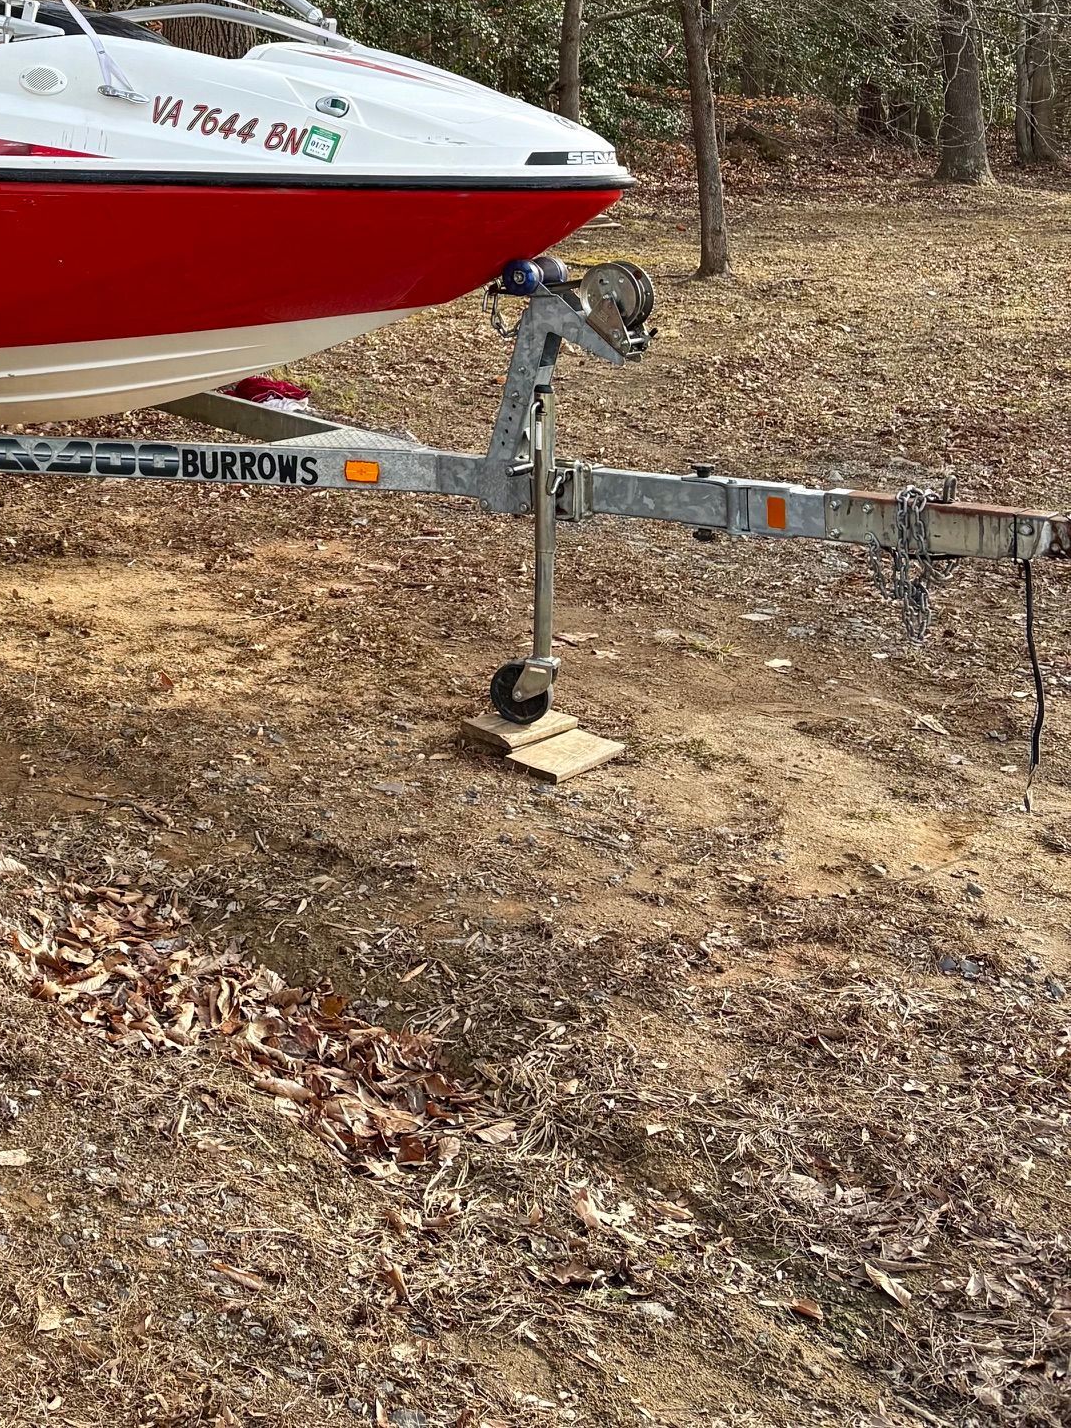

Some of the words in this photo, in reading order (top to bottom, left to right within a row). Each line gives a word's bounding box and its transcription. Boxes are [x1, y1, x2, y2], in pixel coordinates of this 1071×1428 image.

[152, 95, 184, 128] VA
[186, 104, 260, 145] 7644
[263, 122, 309, 156] BN
[181, 448, 319, 485] BURROWS
